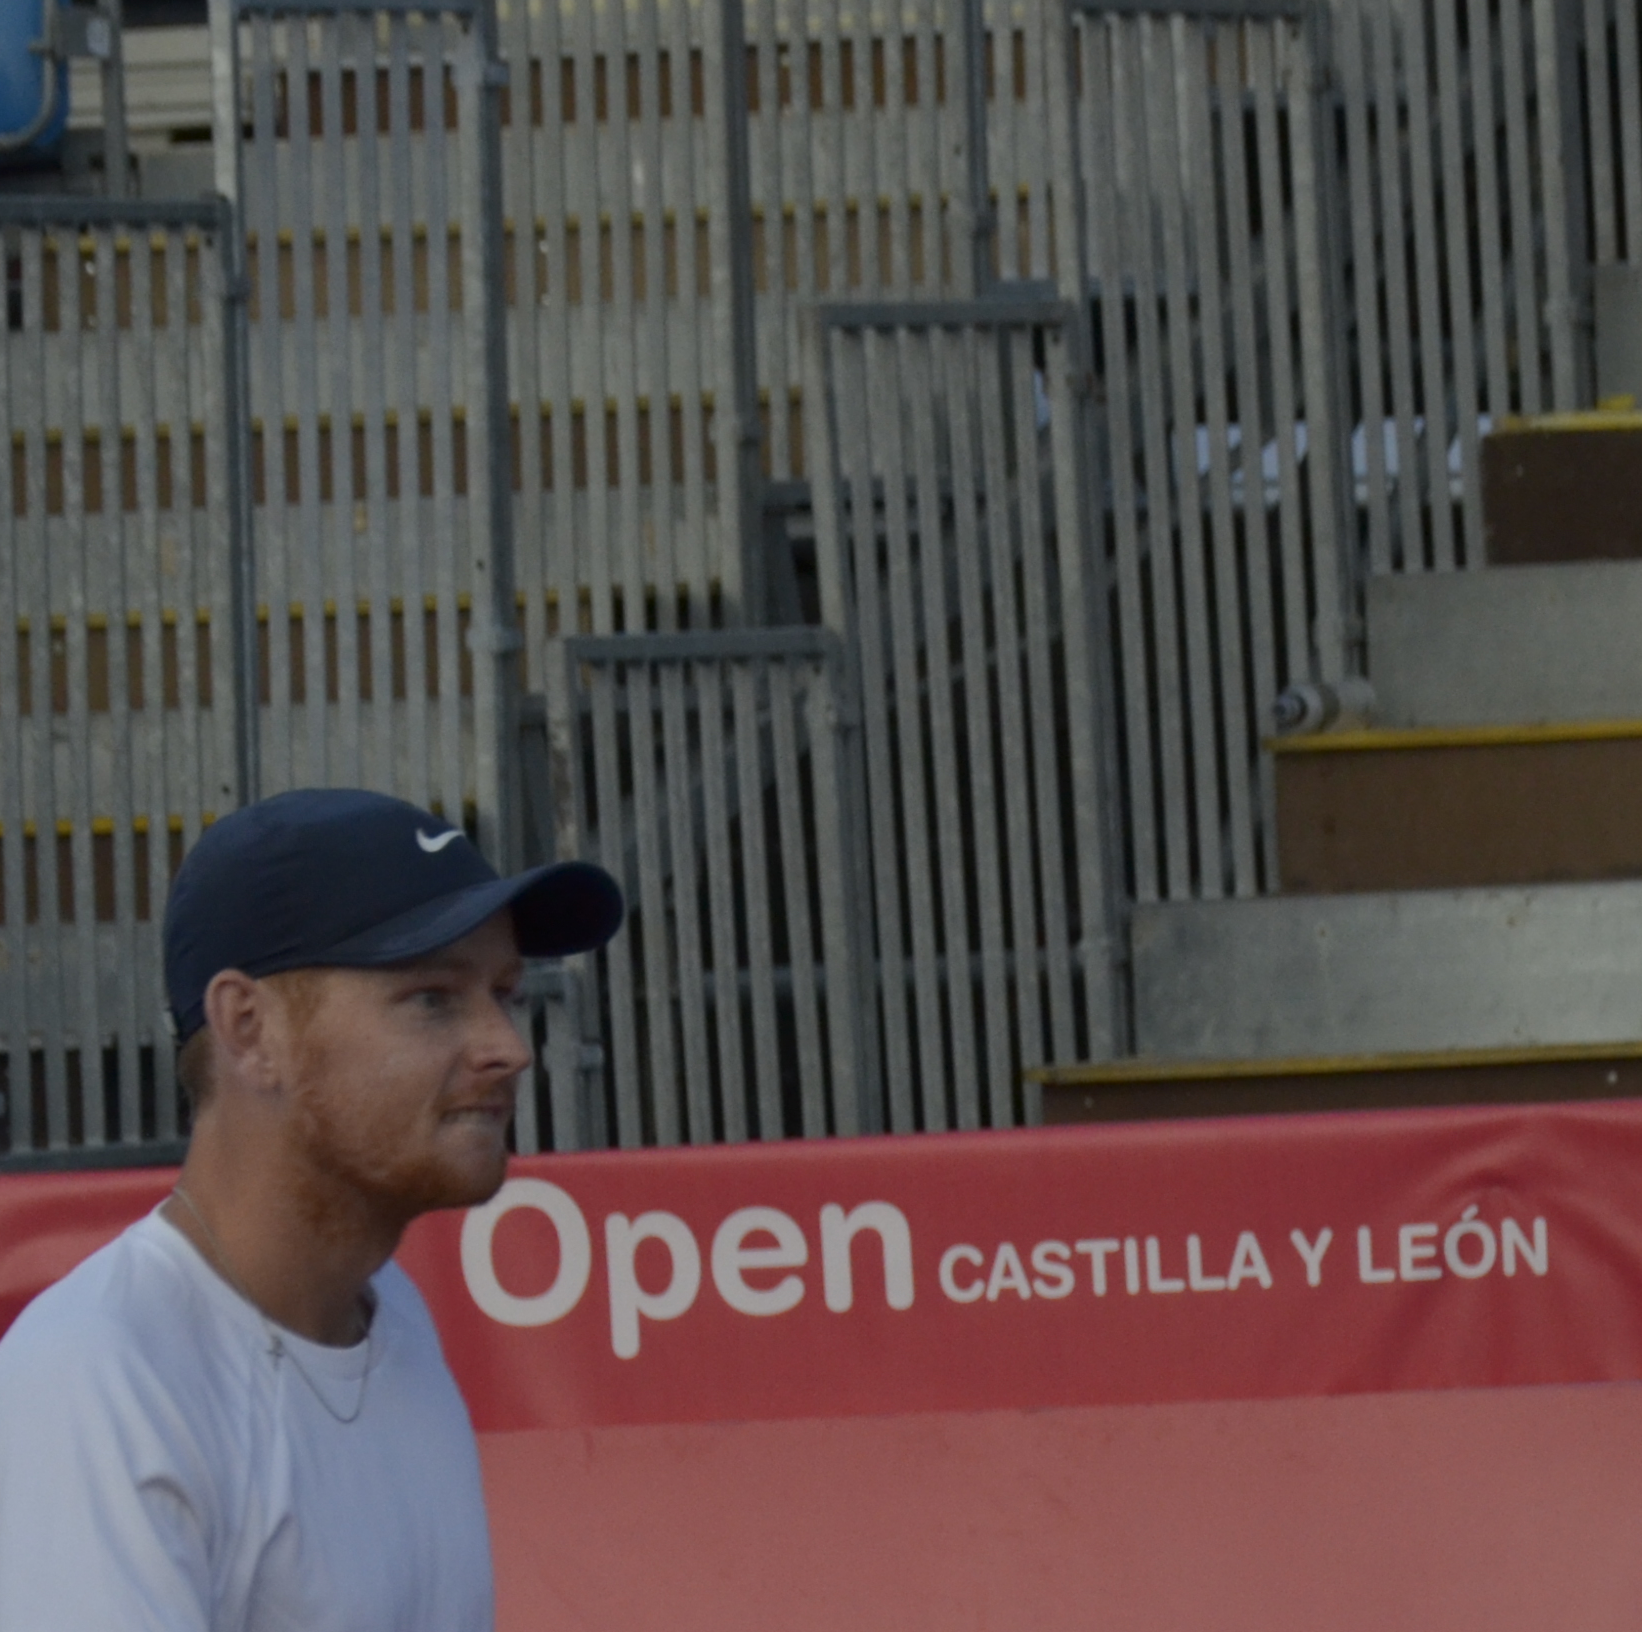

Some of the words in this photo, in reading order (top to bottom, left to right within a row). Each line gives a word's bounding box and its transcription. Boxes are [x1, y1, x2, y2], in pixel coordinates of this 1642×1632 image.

[460, 1177, 915, 1360] Open
[938, 1229, 1272, 1304] CASTILLA
[1289, 1226, 1334, 1288] Y
[1356, 1204, 1550, 1285] LEÓN
